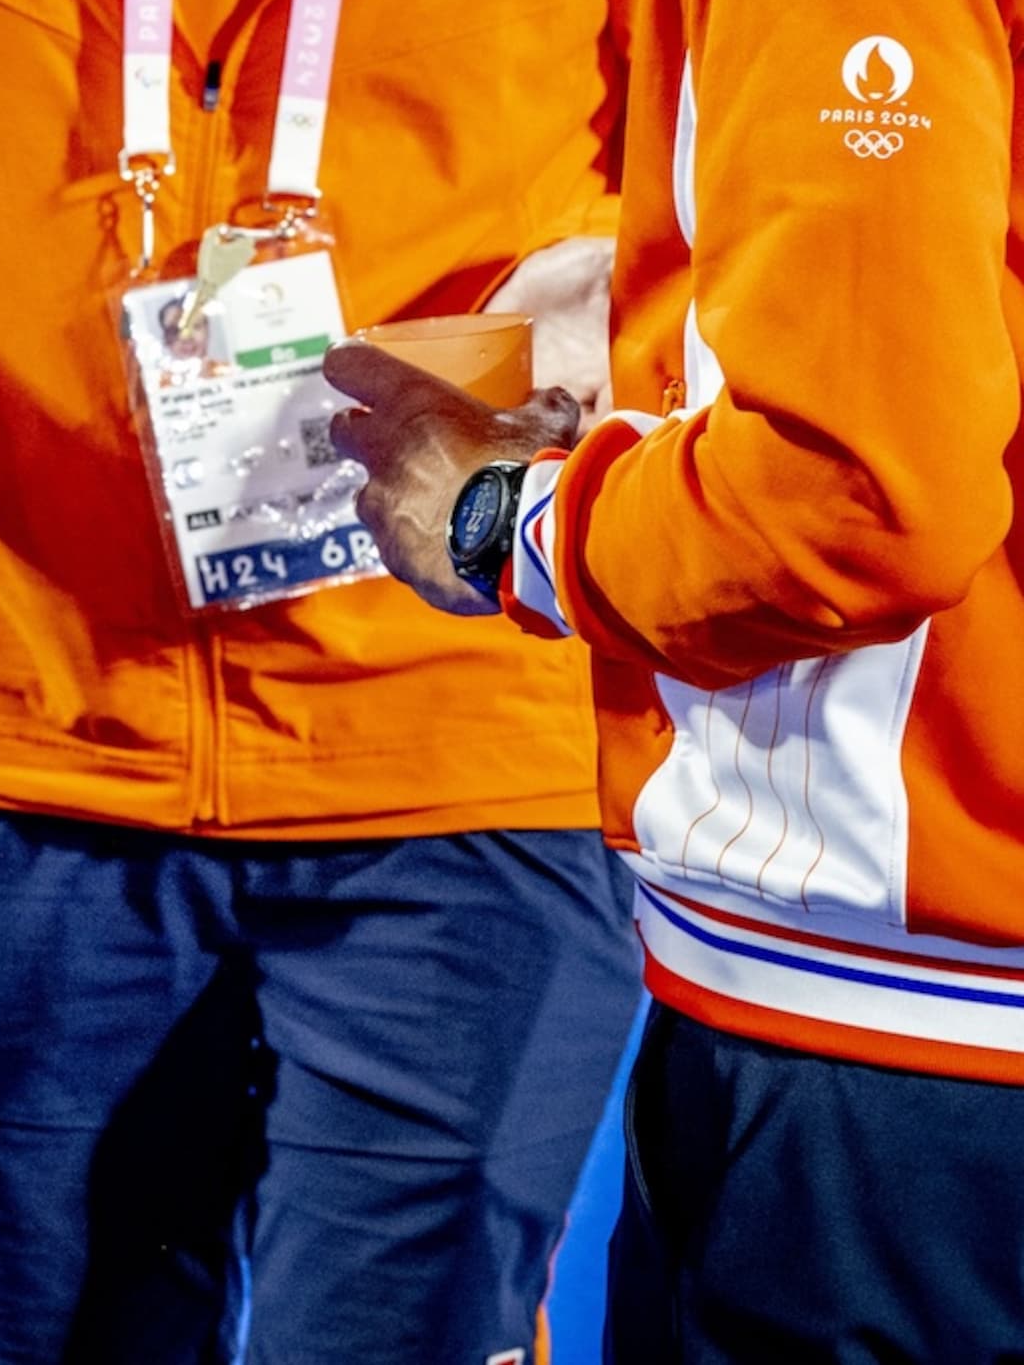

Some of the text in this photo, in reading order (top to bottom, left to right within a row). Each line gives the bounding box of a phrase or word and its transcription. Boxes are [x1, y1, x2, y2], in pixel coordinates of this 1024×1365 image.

[297, 4, 324, 86] 2024
[819, 109, 932, 129] PARIS 2024
